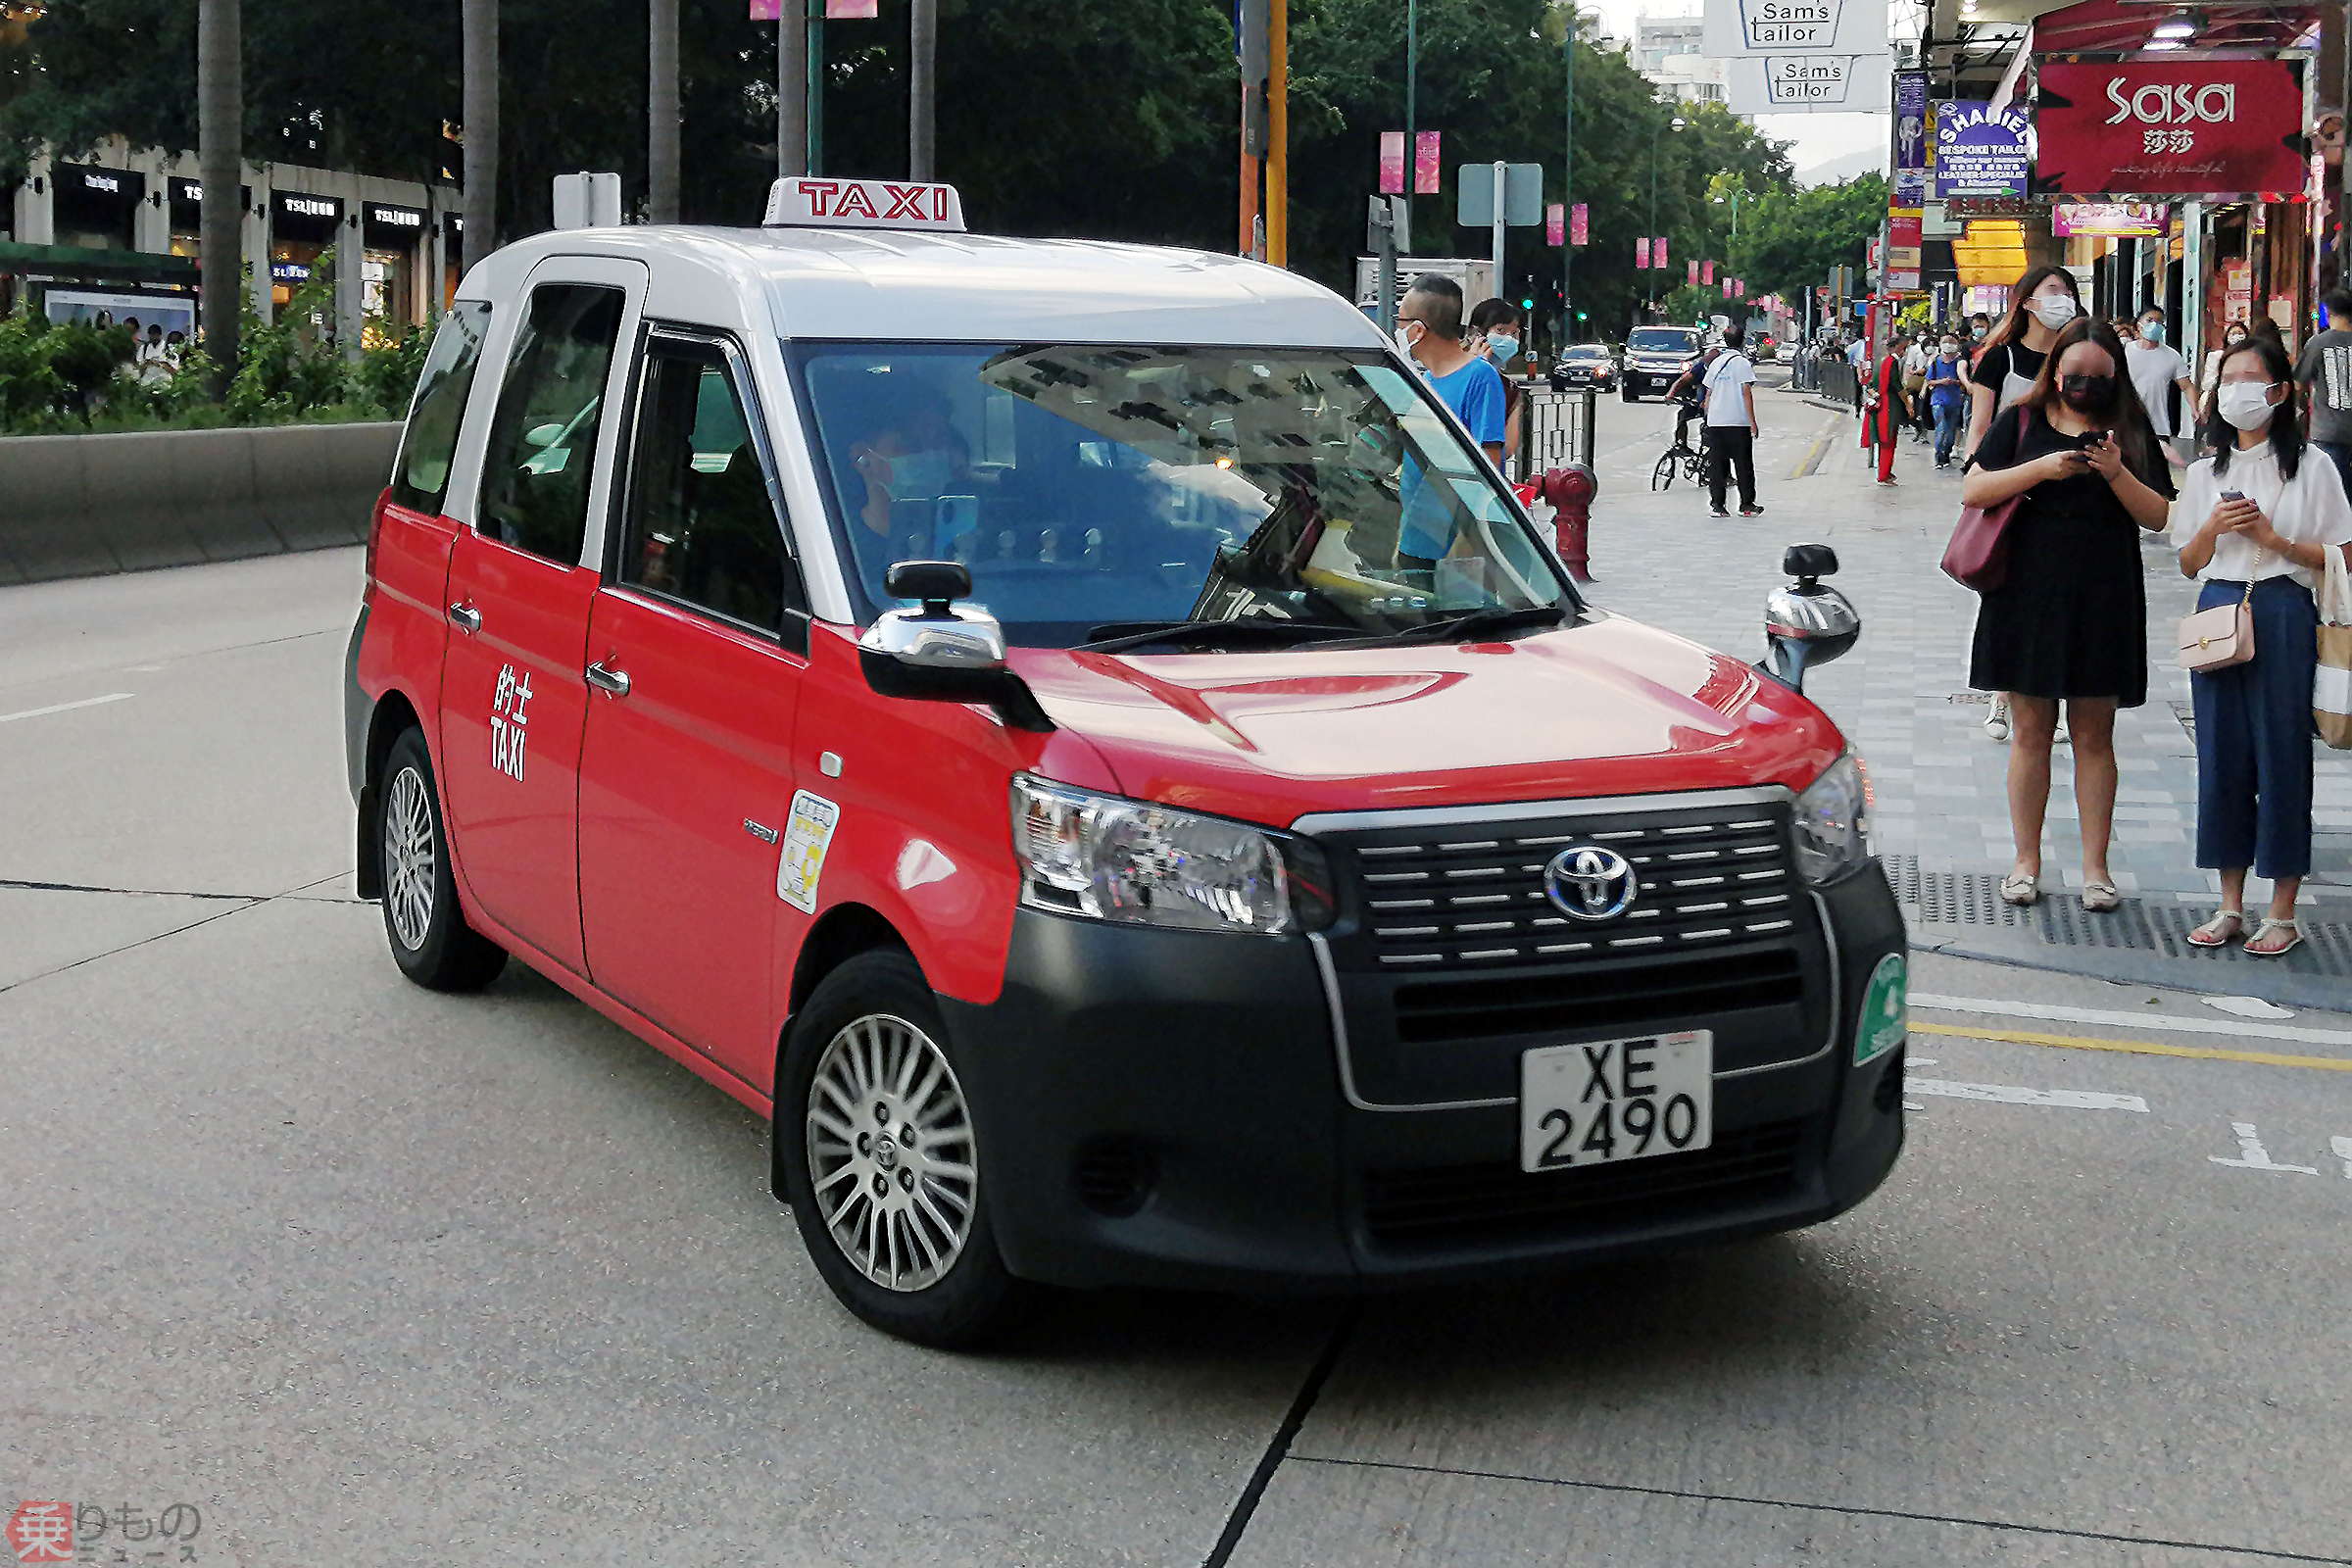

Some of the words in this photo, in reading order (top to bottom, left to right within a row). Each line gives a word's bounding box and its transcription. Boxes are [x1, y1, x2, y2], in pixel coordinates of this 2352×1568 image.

[1764, 0, 1829, 20] Sam's
[1750, 17, 1817, 41] tailor
[1786, 61, 1841, 78] Sam's
[1775, 75, 1831, 97] tailor
[2143, 128, 2194, 154] 莎莎
[184, 185, 204, 201] TS
[798, 181, 948, 221] TAXI
[493, 663, 533, 725] 的士
[490, 715, 526, 782] TAXI
[1581, 1039, 1658, 1102] XE
[1538, 1093, 1698, 1168] 2490
